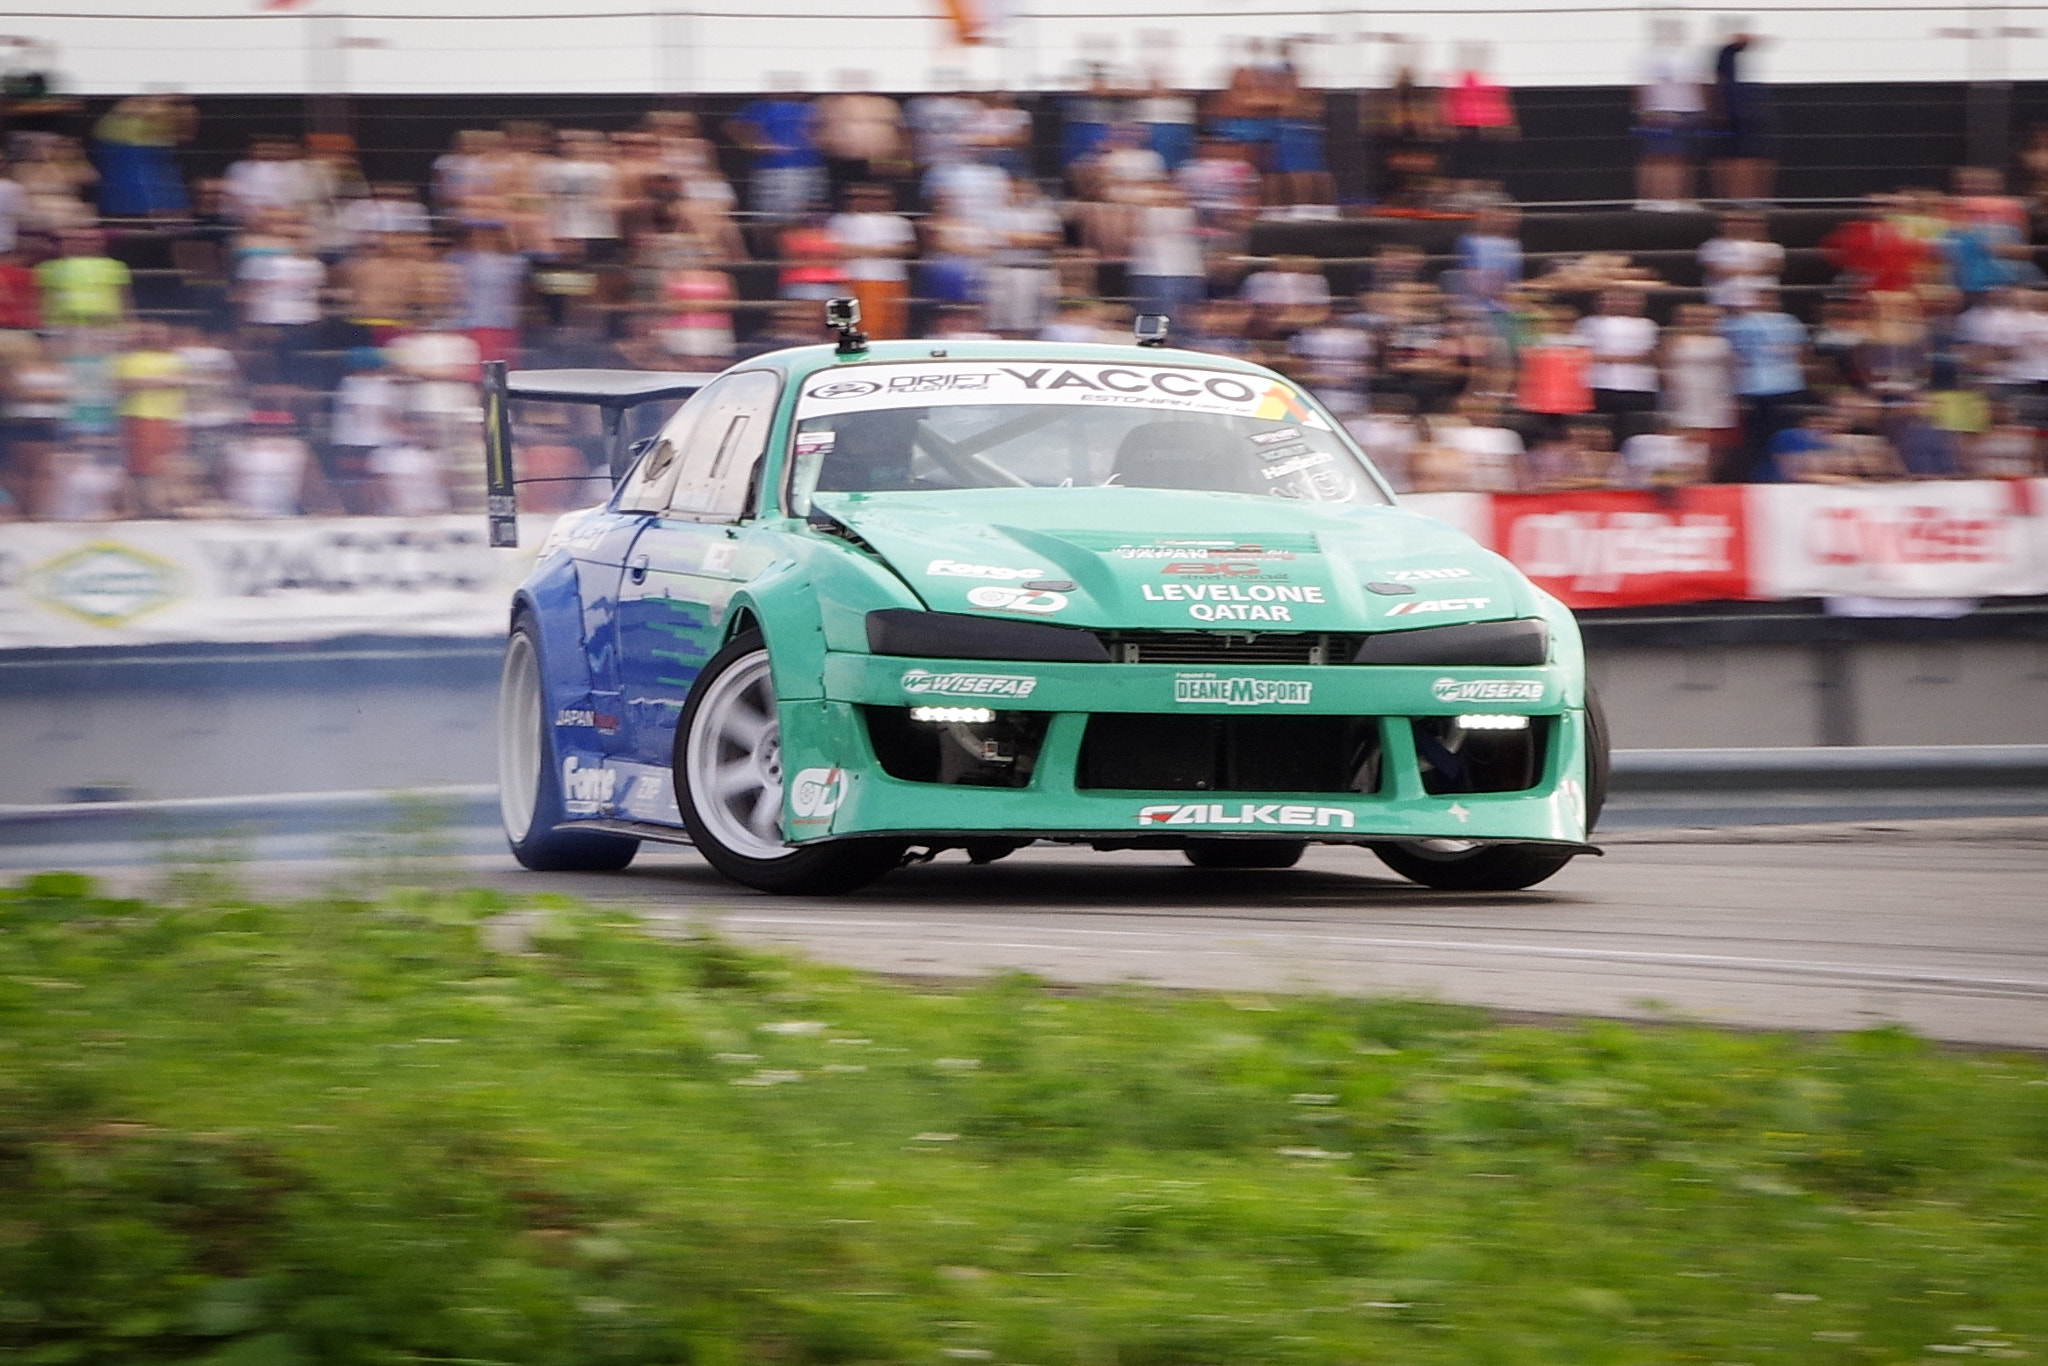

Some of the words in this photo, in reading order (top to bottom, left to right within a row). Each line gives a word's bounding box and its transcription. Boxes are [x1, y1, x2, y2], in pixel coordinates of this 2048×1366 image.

[889, 374, 1001, 387] DRIFT
[997, 367, 1255, 402] YACCO
[1141, 584, 1326, 604] LEVELONE
[1188, 604, 1293, 622] QATAR
[931, 675, 1037, 695] WISEFAB
[1461, 683, 1545, 699] WISEFAB
[1138, 803, 1356, 829] FALKEN
